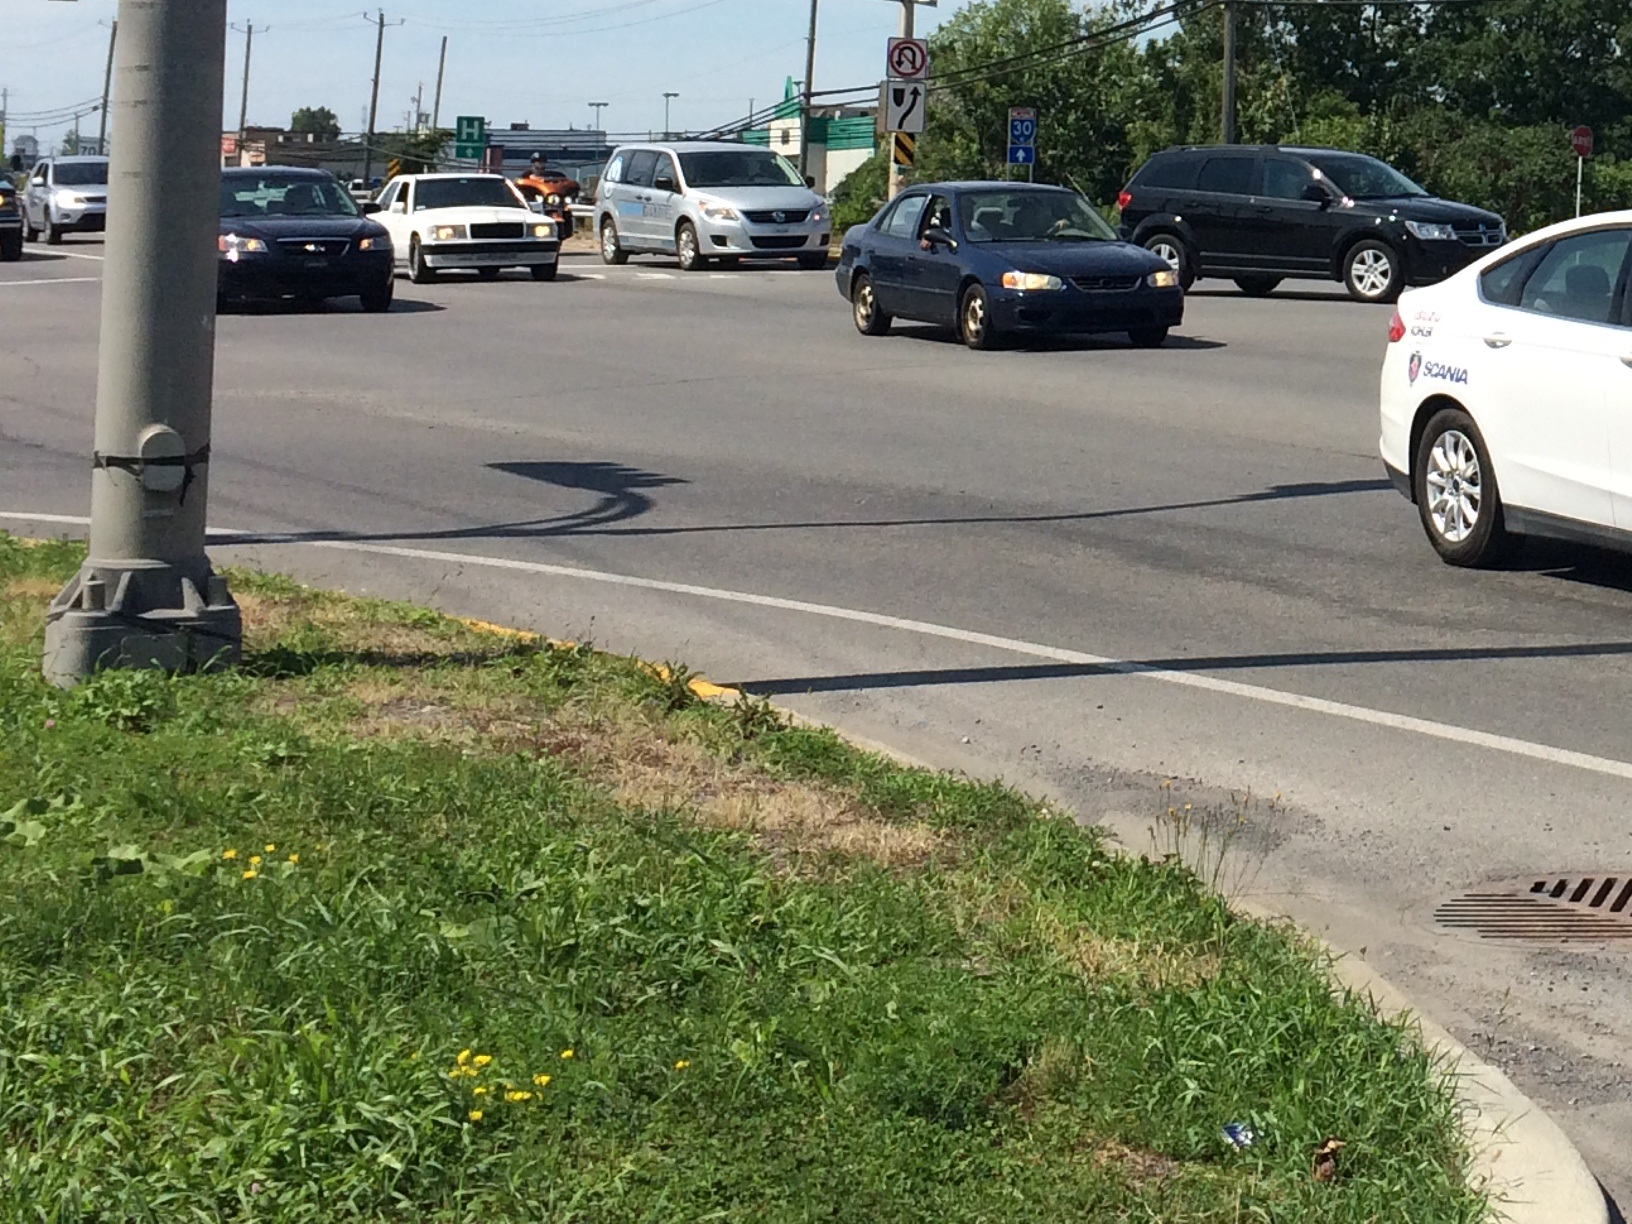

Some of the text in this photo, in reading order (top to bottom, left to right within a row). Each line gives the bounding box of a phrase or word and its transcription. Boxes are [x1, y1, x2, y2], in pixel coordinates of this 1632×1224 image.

[461, 120, 479, 140] H
[1013, 120, 1032, 135] 30
[1422, 360, 1469, 385] SCANIA
